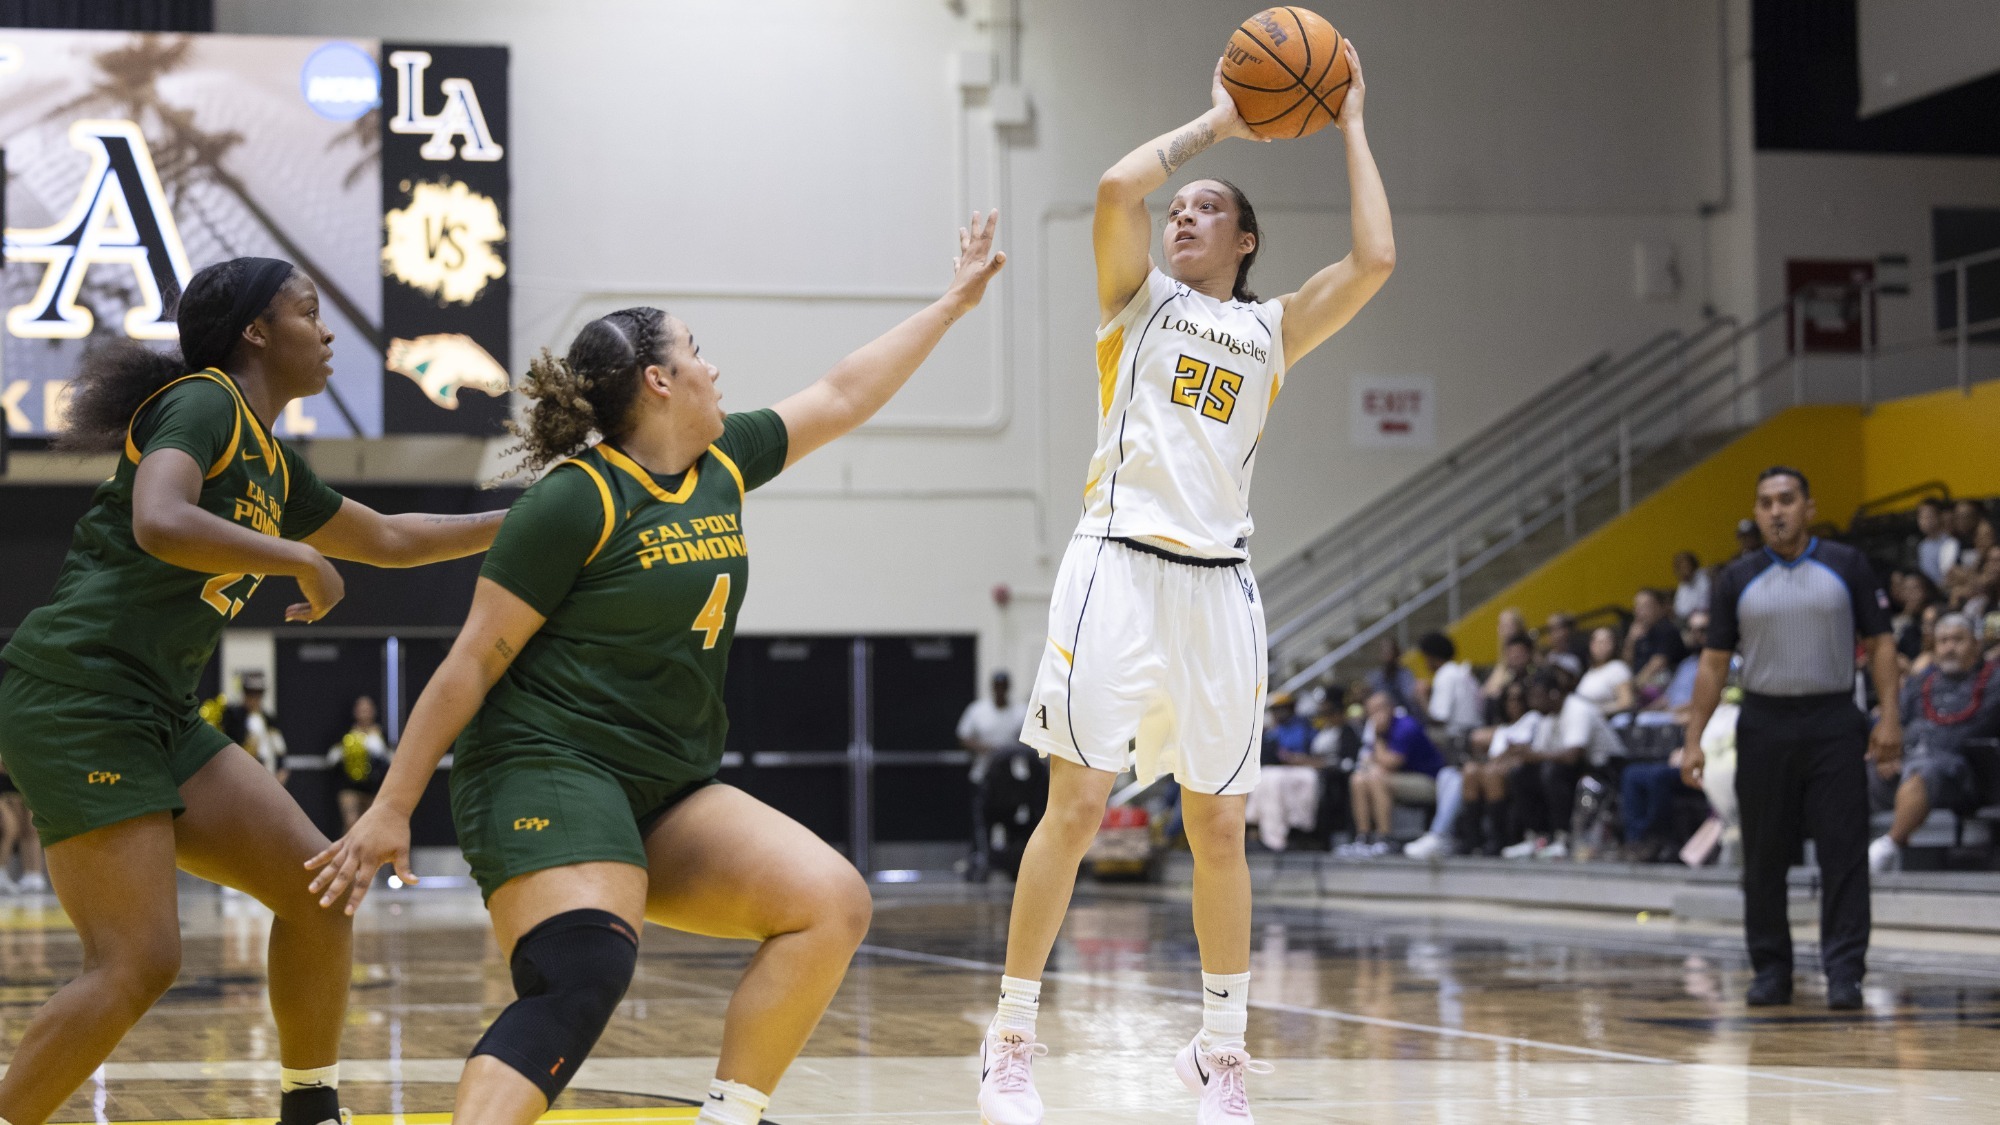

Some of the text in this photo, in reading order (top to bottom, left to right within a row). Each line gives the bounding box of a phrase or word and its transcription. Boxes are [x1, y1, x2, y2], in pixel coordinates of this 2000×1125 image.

[389, 51, 504, 161] LA
[2, 119, 195, 340] A
[425, 215, 468, 271] VS
[1160, 314, 1267, 365] Los Angeles
[1170, 353, 1245, 425] 25
[246, 479, 269, 511] CAL
[638, 513, 739, 547] CAL POLY
[691, 572, 731, 650] 4
[1034, 703, 1050, 731] A
